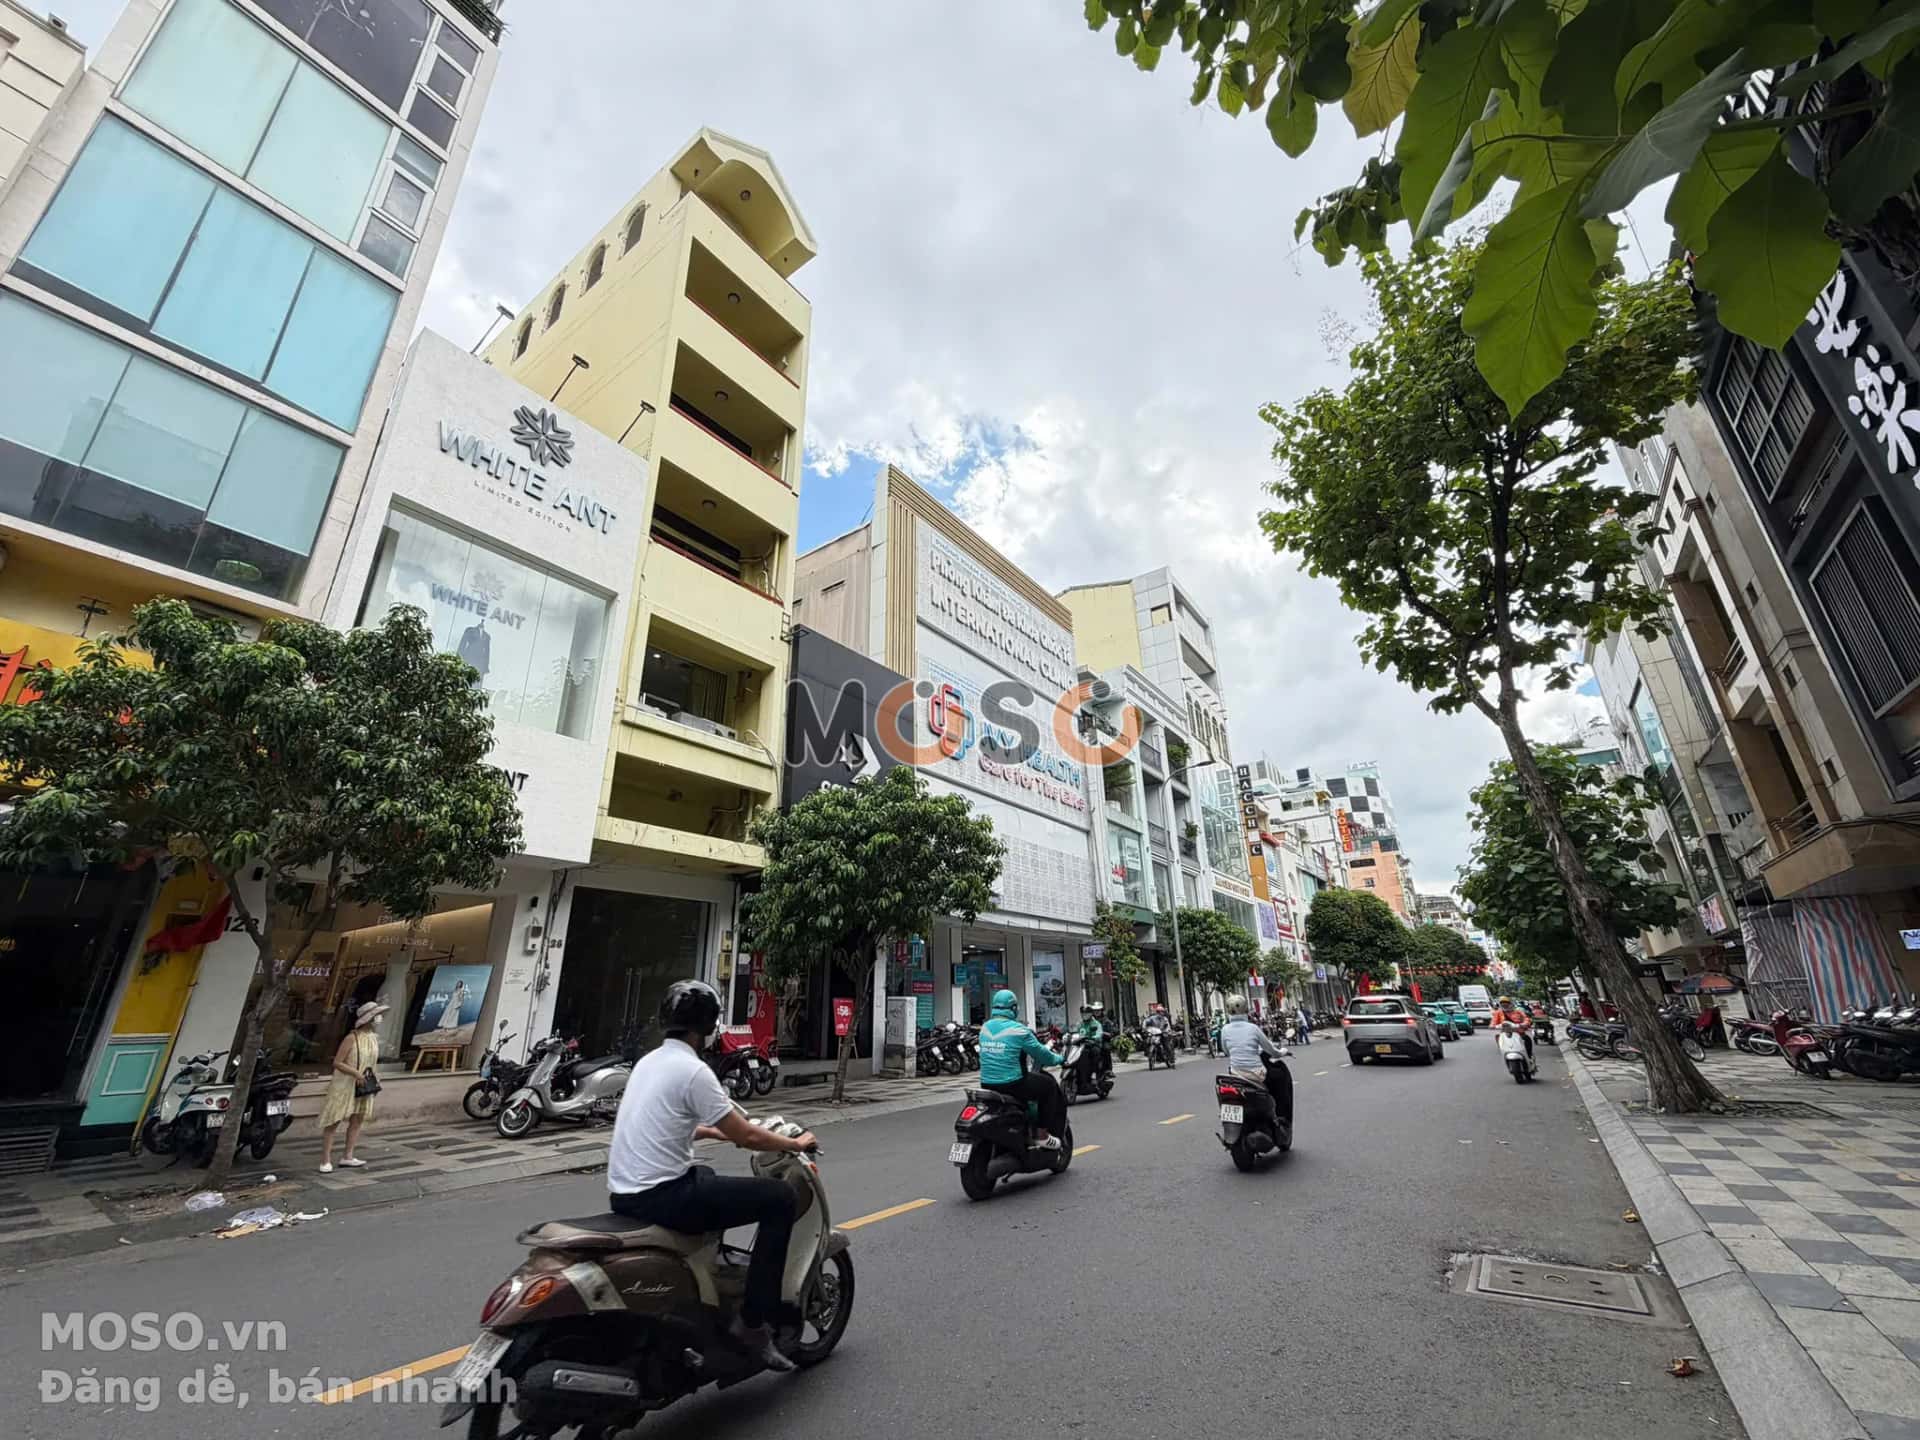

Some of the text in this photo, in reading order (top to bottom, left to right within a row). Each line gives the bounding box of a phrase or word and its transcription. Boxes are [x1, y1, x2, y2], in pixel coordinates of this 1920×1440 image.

[438, 418, 617, 535] WHITE ANT
[474, 479, 521, 508] LIMITED
[432, 582, 526, 630] WHITE ANT
[930, 580, 1038, 673] INTERNATIONAL
[504, 769, 529, 791] NT
